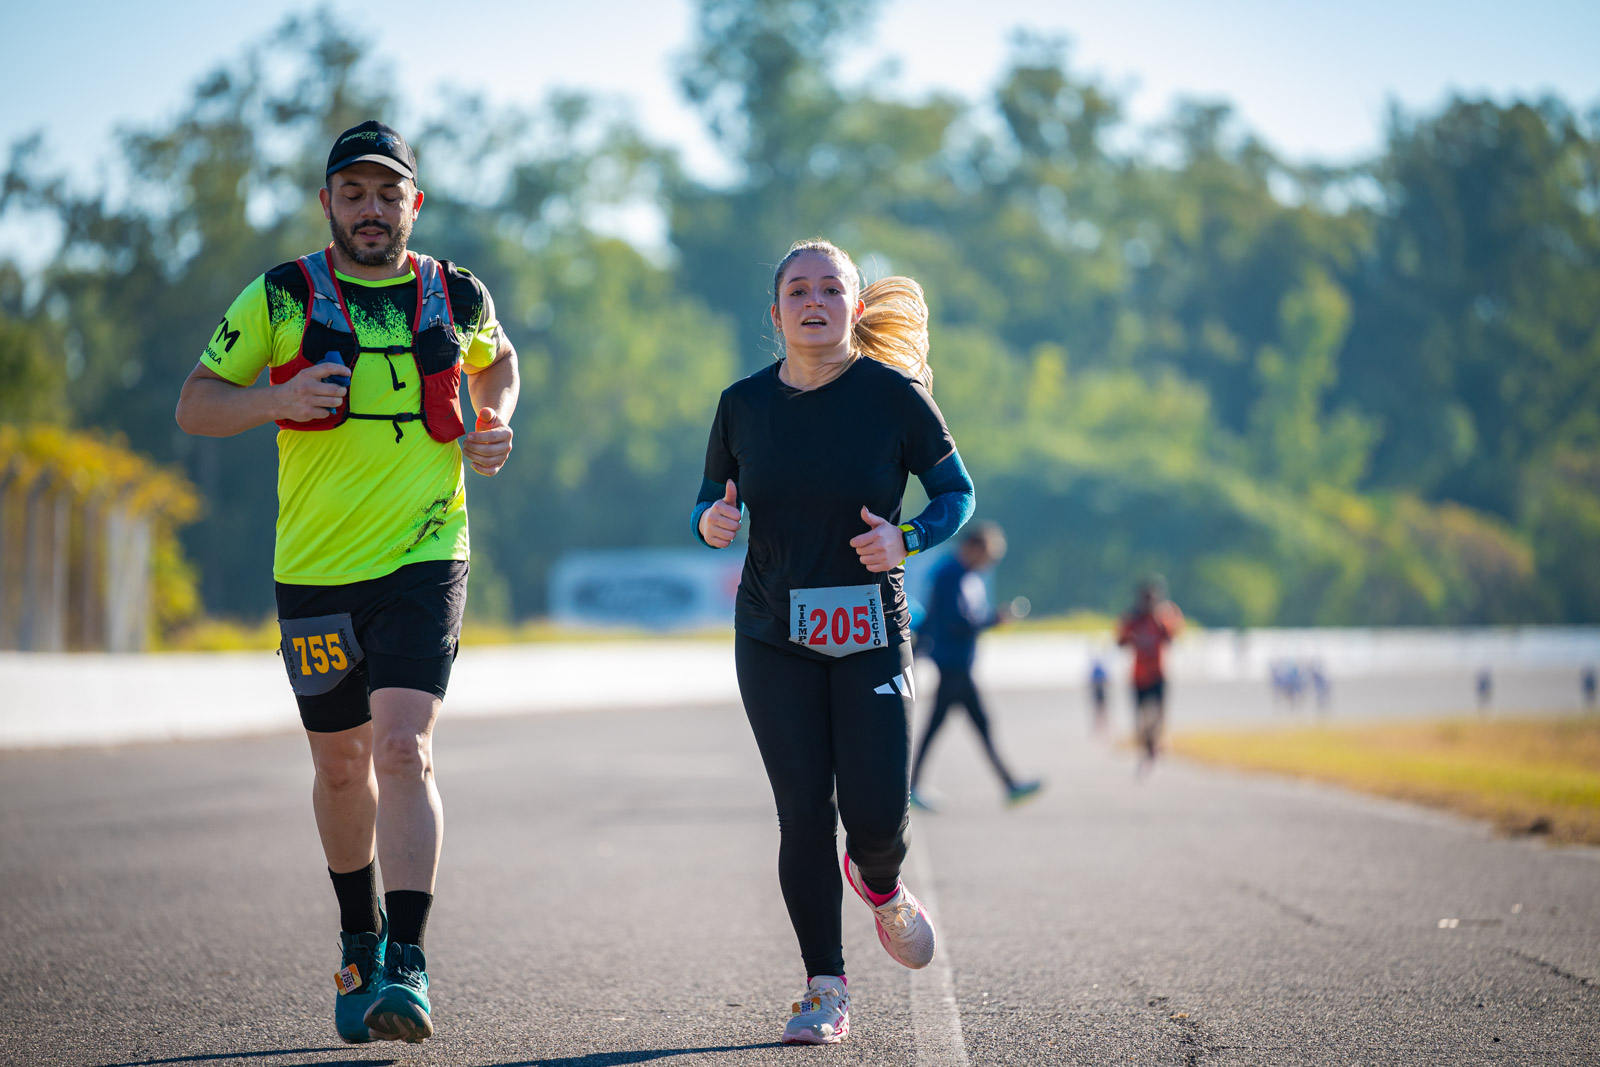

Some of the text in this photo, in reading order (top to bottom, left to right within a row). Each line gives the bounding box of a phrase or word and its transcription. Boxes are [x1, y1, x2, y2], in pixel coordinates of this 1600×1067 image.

[808, 606, 871, 645] 205
[868, 599, 881, 646] EXACTO
[292, 633, 348, 676] 755
[342, 971, 354, 988] 755
